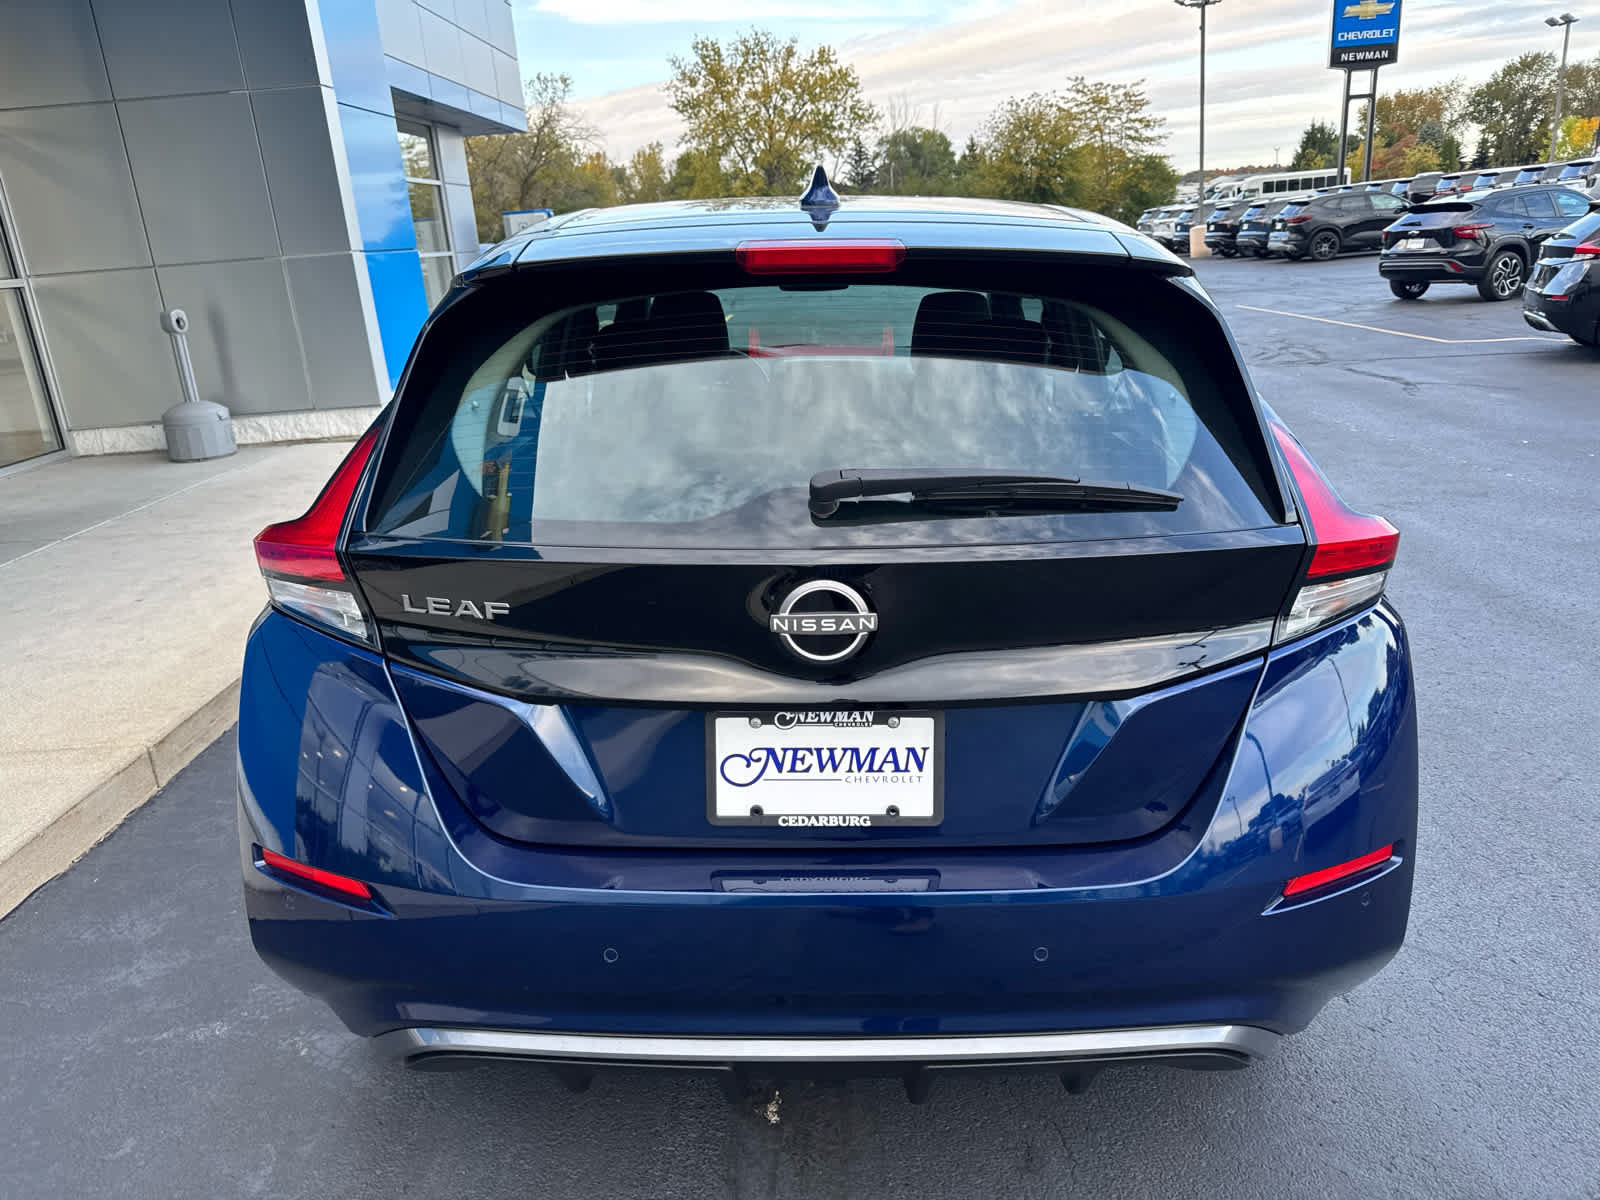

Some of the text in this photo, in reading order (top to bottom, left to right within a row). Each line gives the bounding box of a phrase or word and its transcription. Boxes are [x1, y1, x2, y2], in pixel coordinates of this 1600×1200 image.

[1337, 28, 1395, 41] CHEVROLET
[1340, 50, 1389, 62] NEWMAN
[401, 594, 510, 620] LEAF
[772, 617, 876, 632] NISSAN
[774, 711, 874, 730] NEWMAN
[720, 747, 930, 787] NEWMAN
[844, 775, 924, 784] CHEVROLET
[778, 815, 872, 827] CEDARBURG
